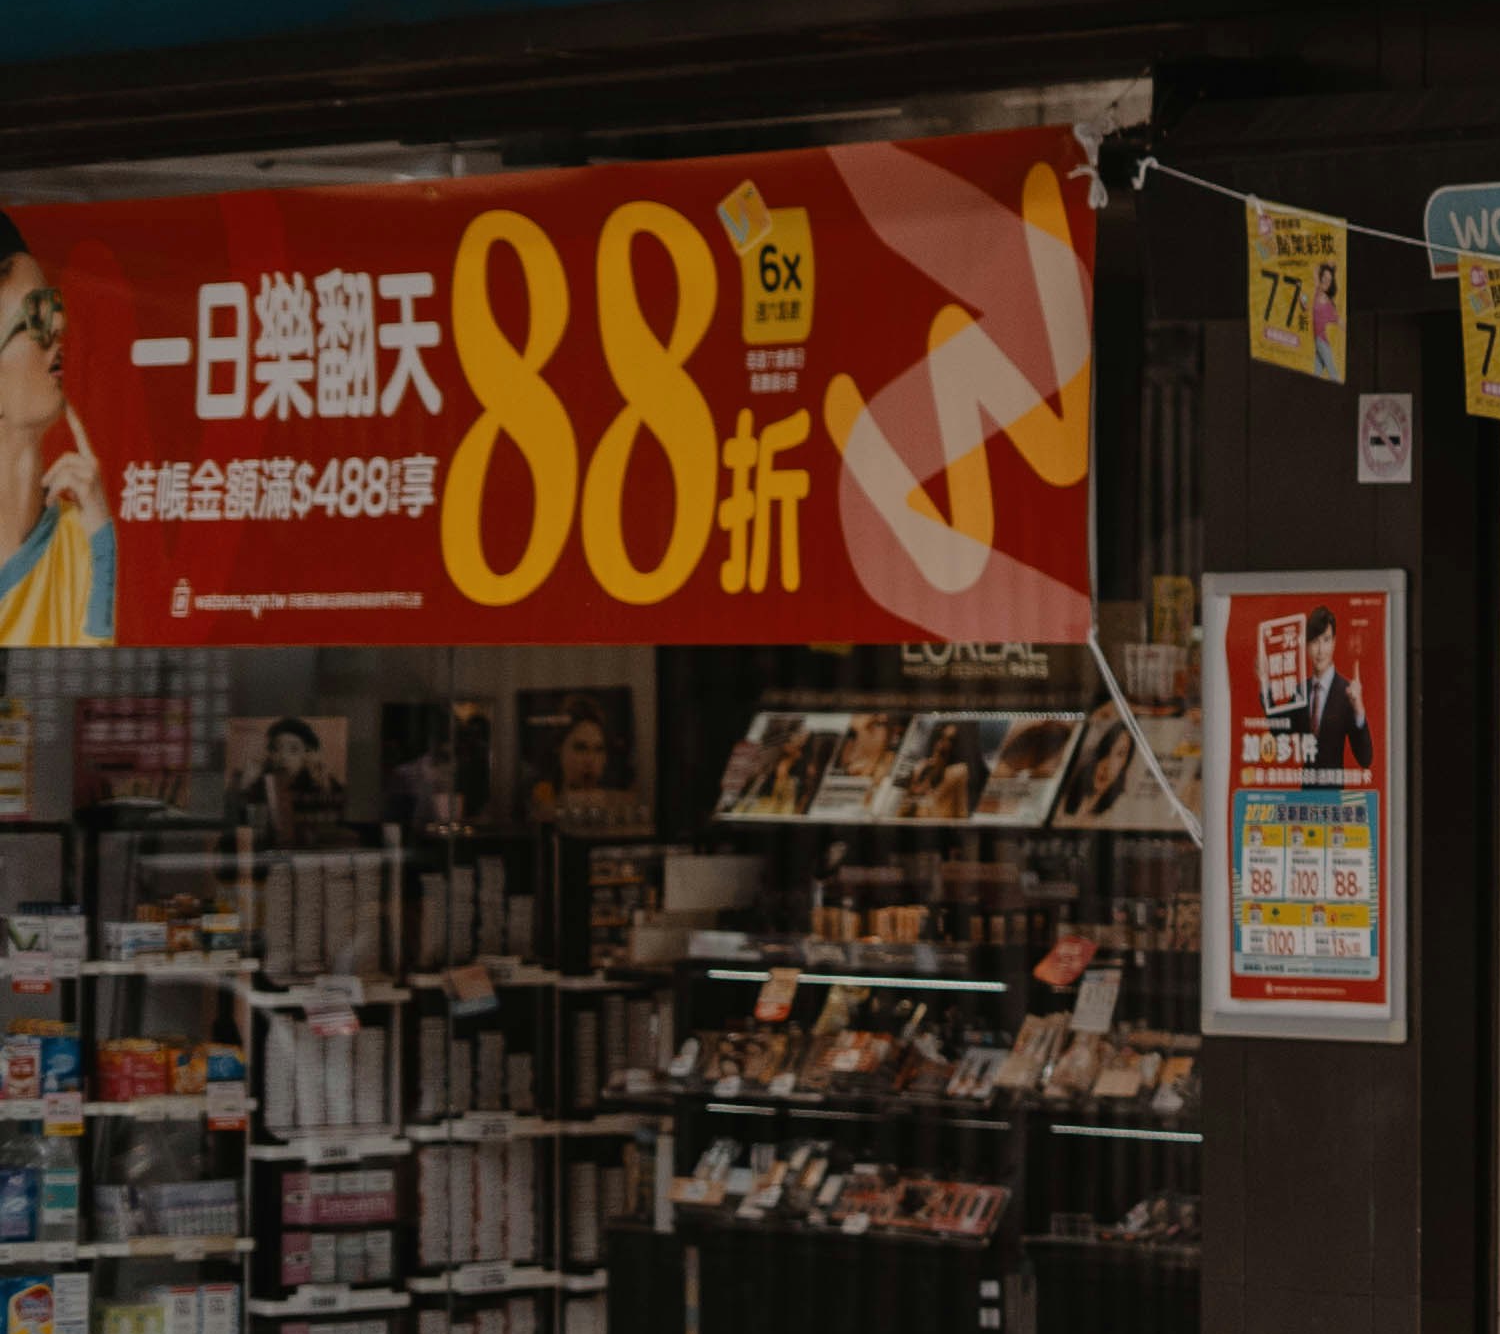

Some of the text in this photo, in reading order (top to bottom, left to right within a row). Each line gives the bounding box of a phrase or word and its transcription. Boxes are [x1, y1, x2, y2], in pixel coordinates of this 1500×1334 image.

[130, 269, 443, 421] 一日樂翻天
[1261, 269, 1302, 328] 77
[719, 408, 810, 594] 折
